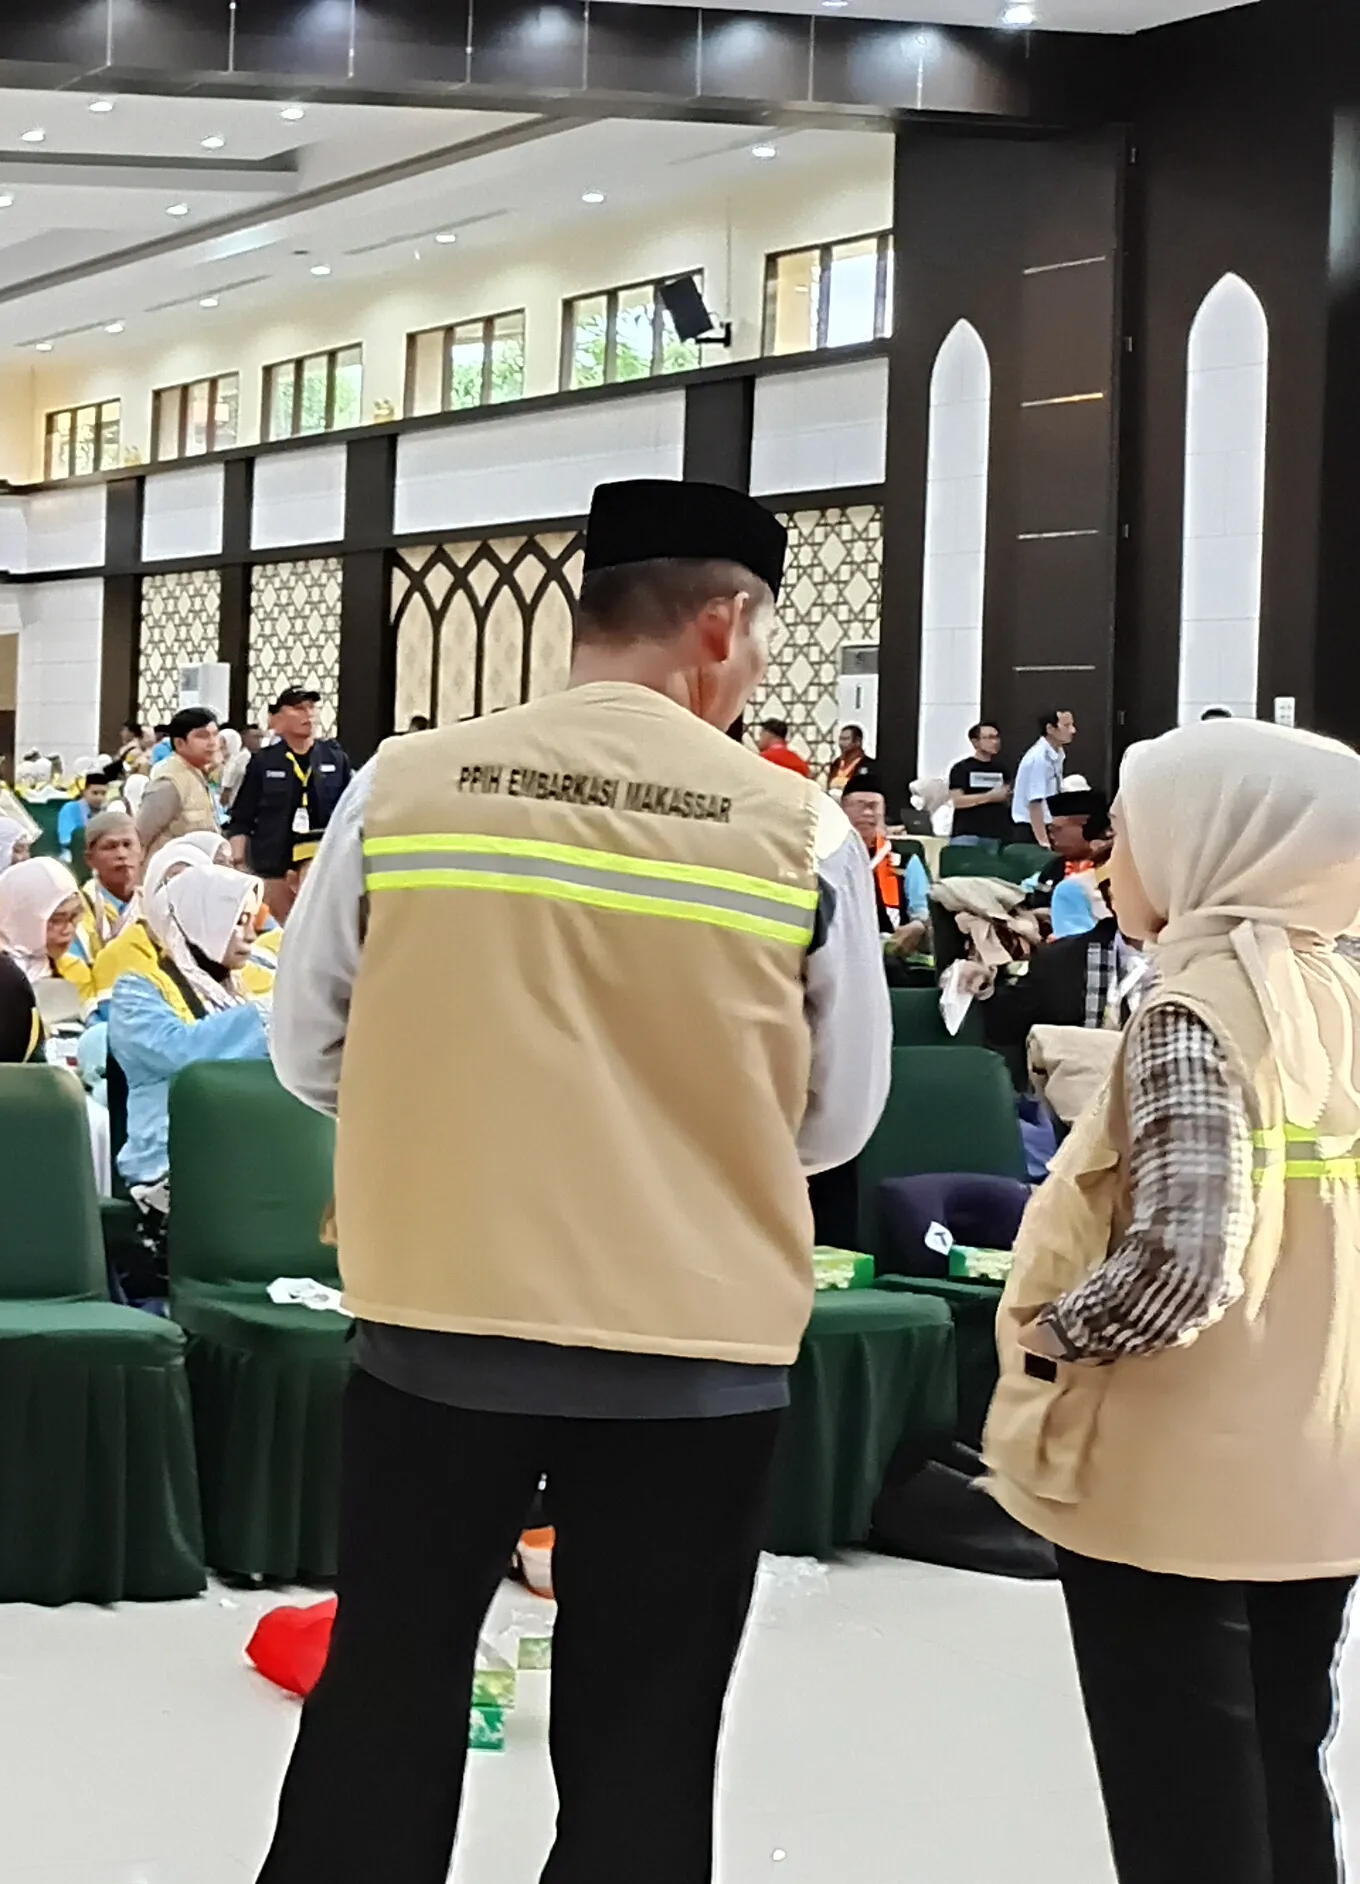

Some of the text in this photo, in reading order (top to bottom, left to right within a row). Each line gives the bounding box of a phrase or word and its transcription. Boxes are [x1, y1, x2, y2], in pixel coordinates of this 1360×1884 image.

[457, 765, 731, 823] PPIH EMBARKASI MAKASSAR
